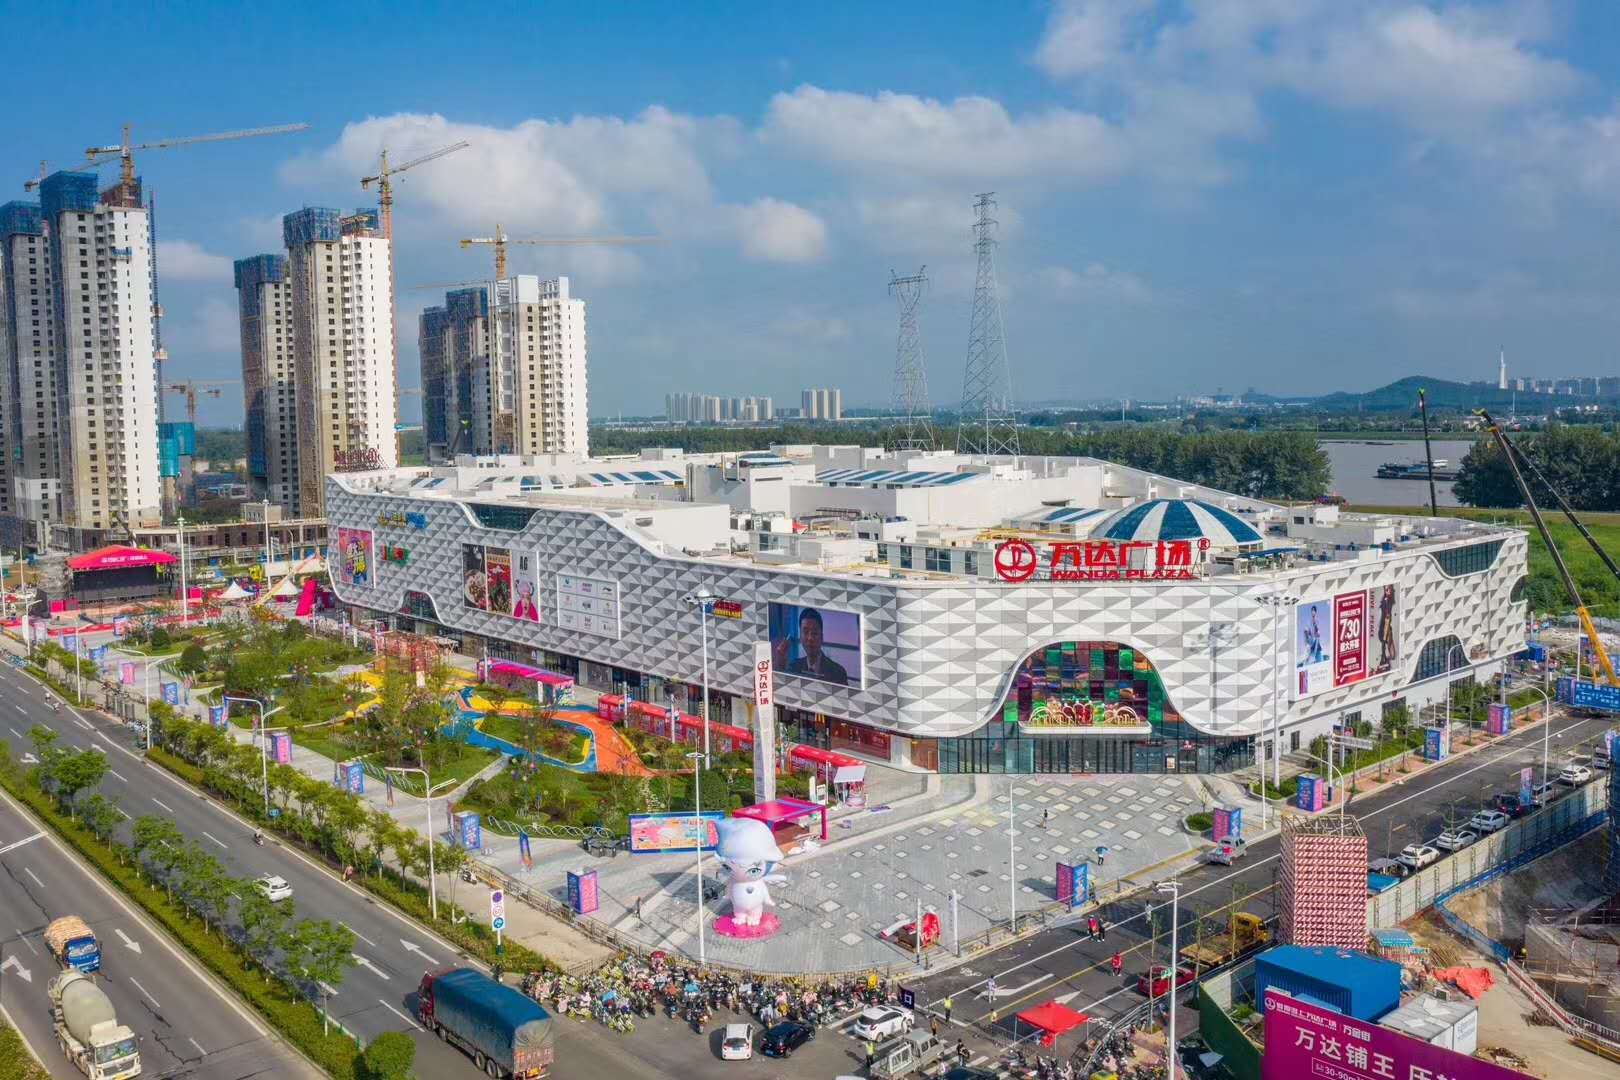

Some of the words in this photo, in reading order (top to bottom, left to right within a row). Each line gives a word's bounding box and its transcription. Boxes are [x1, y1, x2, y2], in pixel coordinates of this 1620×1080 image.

[1048, 541, 1192, 567] 万达广场
[1051, 569, 1120, 581] WANDA
[1125, 569, 1194, 580] PLAZA
[759, 673, 769, 705] 万达广场
[1295, 1026, 1395, 1079] 万达铺王
